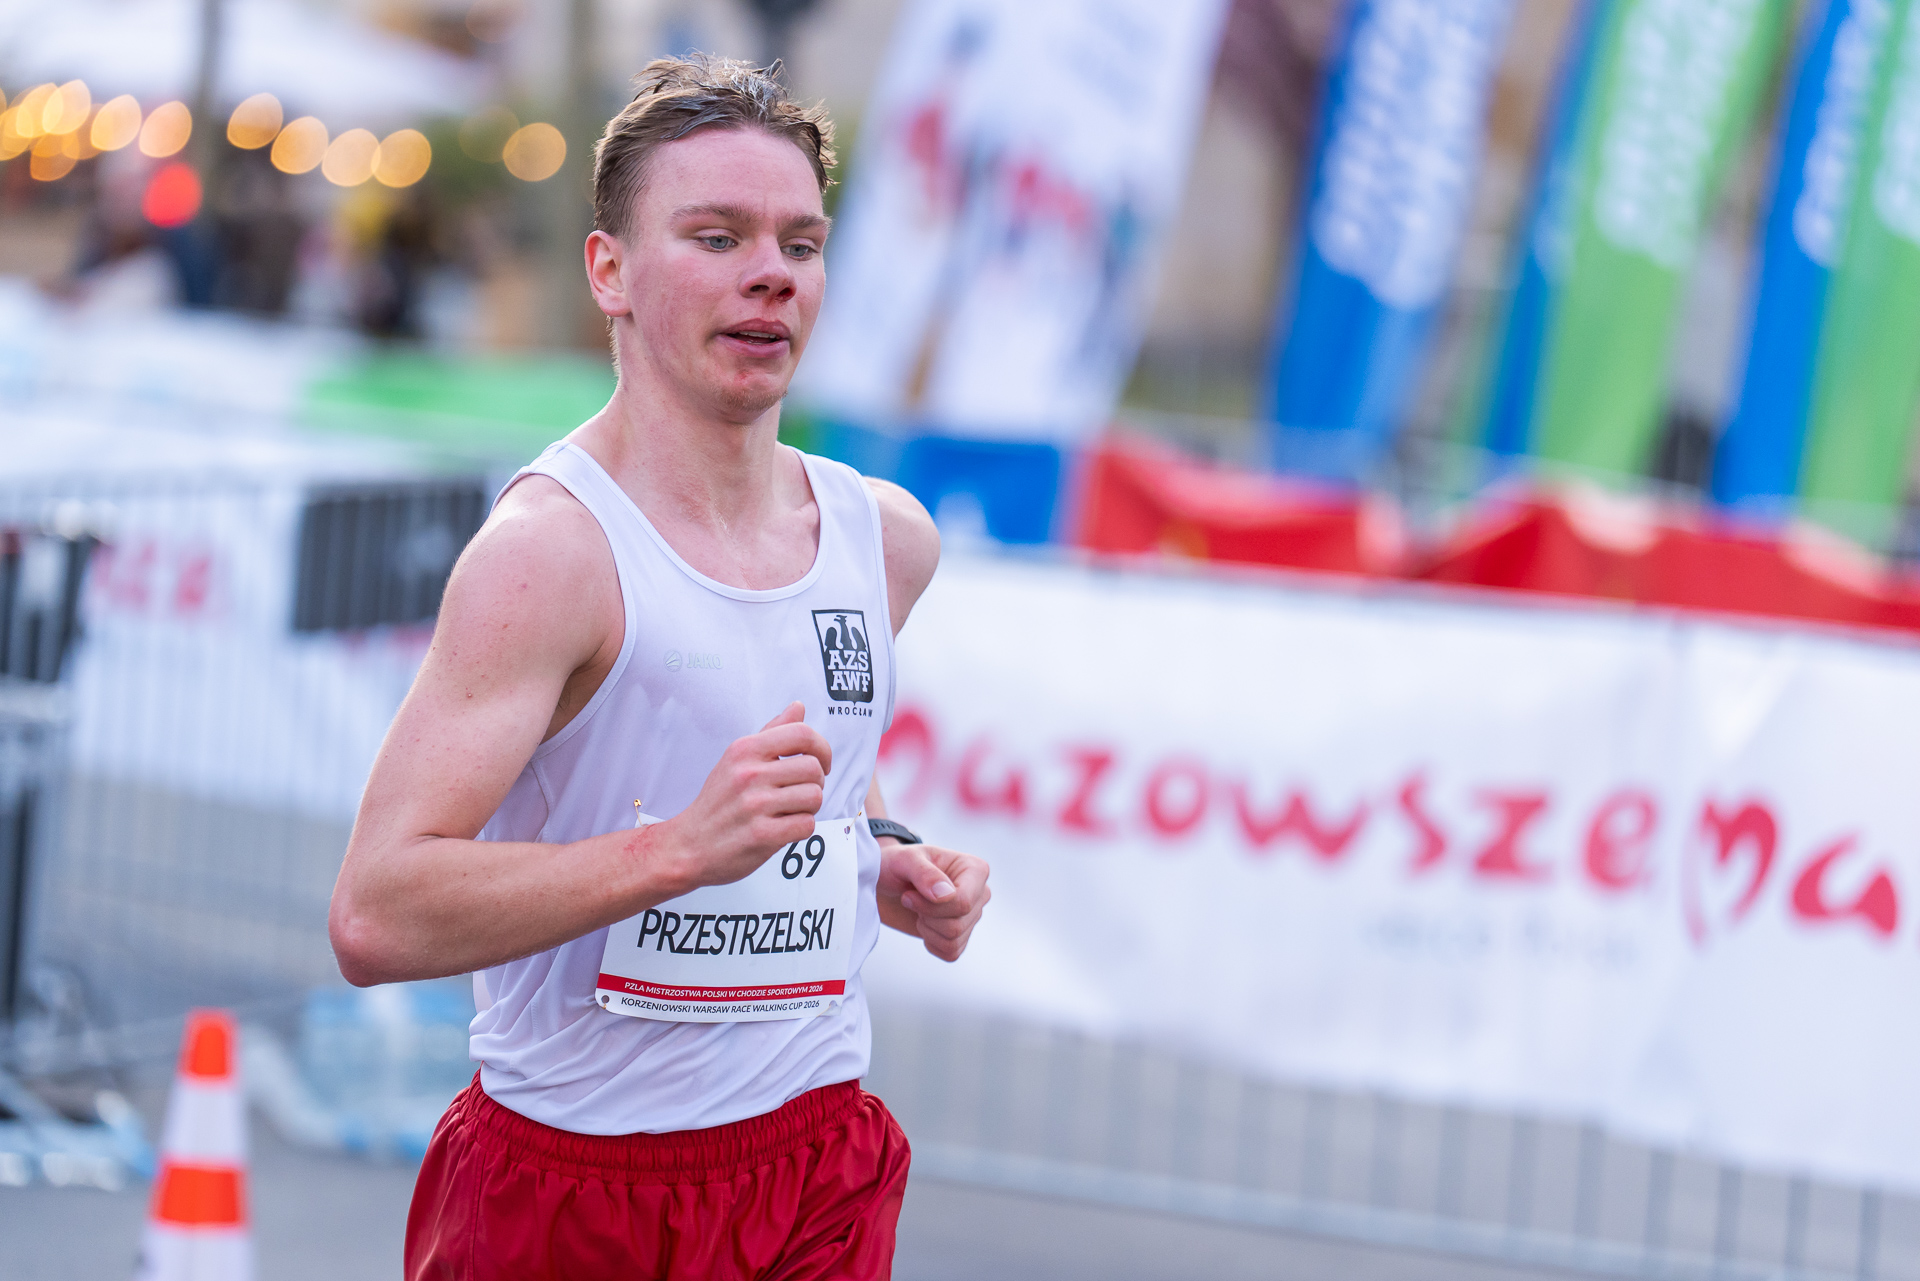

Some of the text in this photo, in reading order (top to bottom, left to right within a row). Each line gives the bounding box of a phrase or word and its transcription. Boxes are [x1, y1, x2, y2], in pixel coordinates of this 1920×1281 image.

[687, 652, 724, 670] JAKO
[828, 650, 869, 671] AZS
[831, 671, 871, 692] AWF
[781, 834, 826, 880] 69
[637, 908, 835, 956] PRZESTRZELSKI
[624, 981, 823, 998] PZLA MISTRZOSTWA POLSKI W CHODZIE SPORTOWYM 2026
[621, 997, 820, 1014] KORZENIOWSKI WARSAW RACE WALKING CUP 2026
